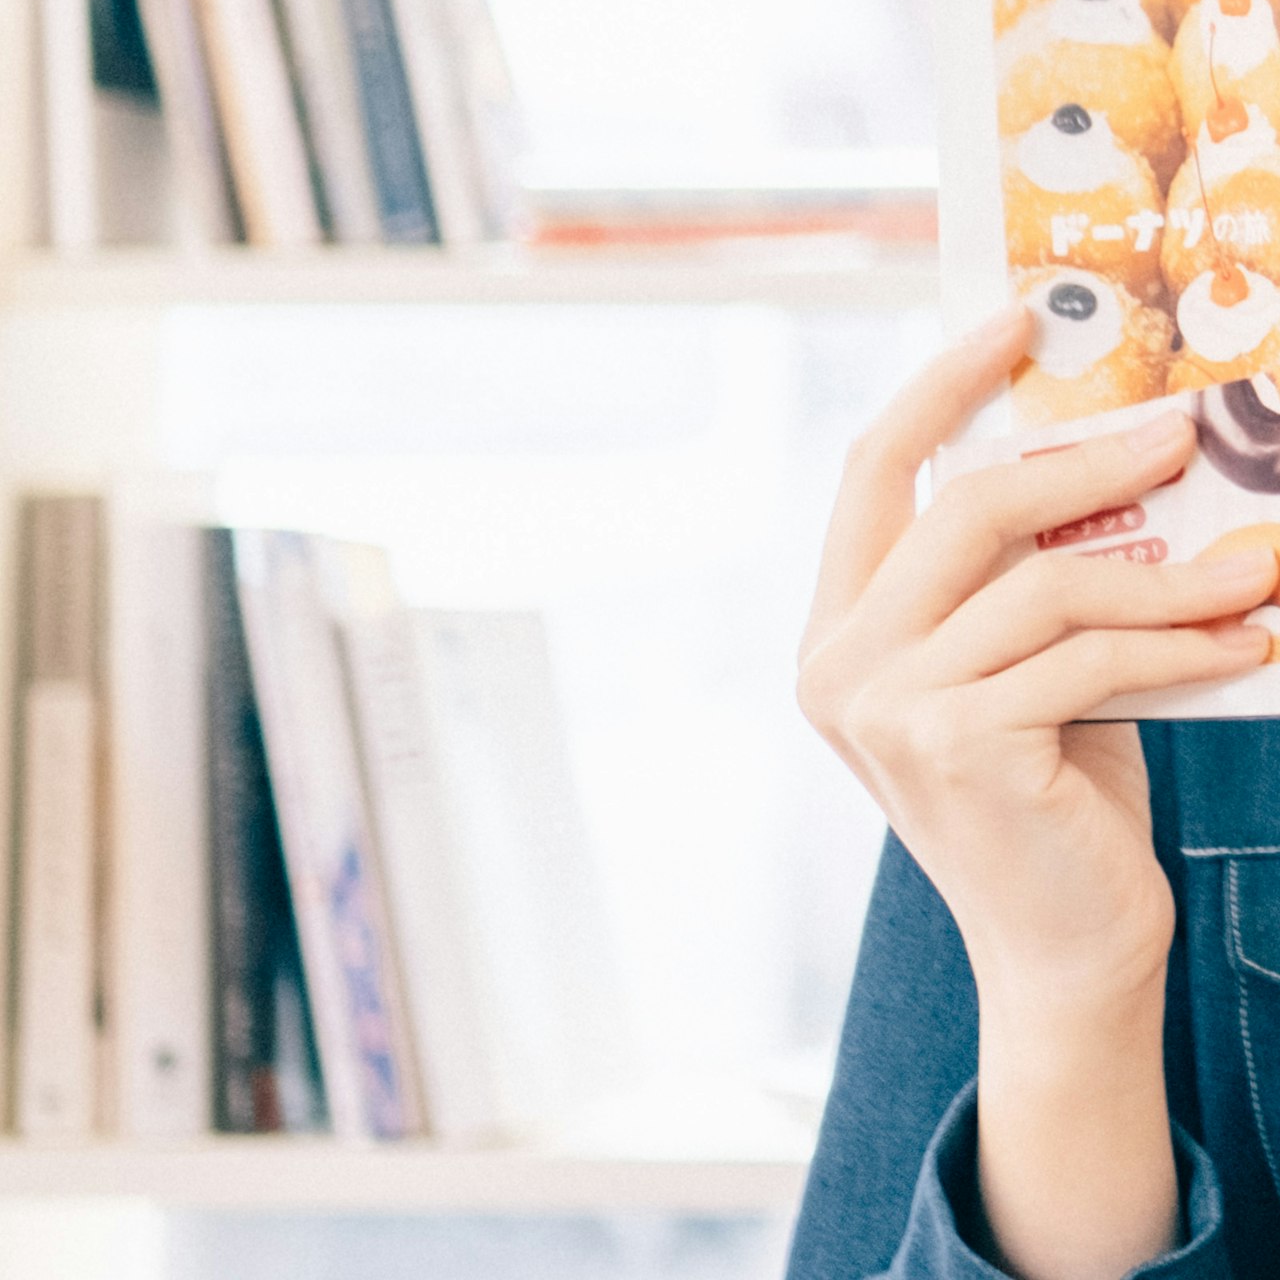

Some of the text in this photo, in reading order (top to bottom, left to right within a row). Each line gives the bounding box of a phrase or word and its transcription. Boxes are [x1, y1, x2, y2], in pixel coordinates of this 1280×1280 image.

[1051, 209, 1269, 256] ドーナツの旅
